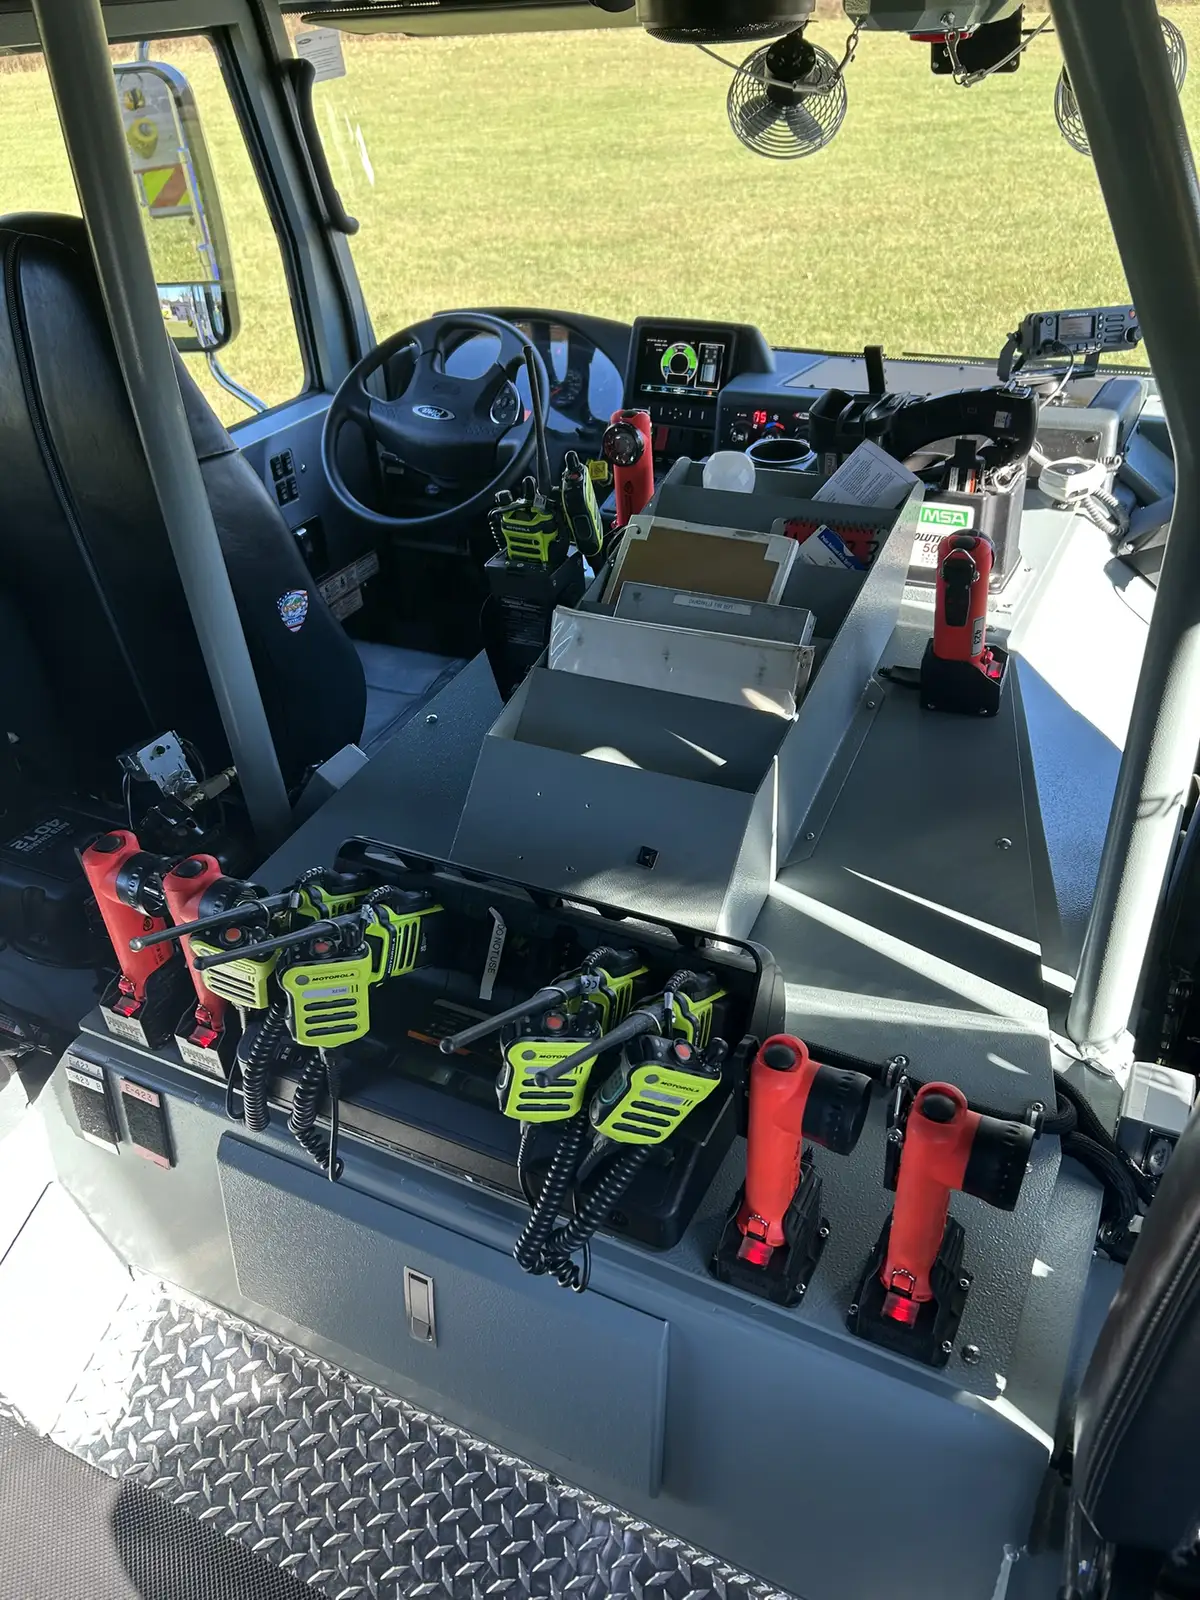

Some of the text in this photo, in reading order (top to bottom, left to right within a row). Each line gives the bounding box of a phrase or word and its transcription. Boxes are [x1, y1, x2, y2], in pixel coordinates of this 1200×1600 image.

[753, 411, 767, 424] 75
[922, 508, 966, 526] MSA
[922, 543, 939, 554] 50
[973, 629, 982, 645] 423
[10, 818, 60, 850] 4012
[487, 923, 505, 974] DO NOT USE
[311, 972, 355, 982] MOTOROLA
[125, 1083, 153, 1102] E-423
[660, 1081, 701, 1093] MOTOROLA
